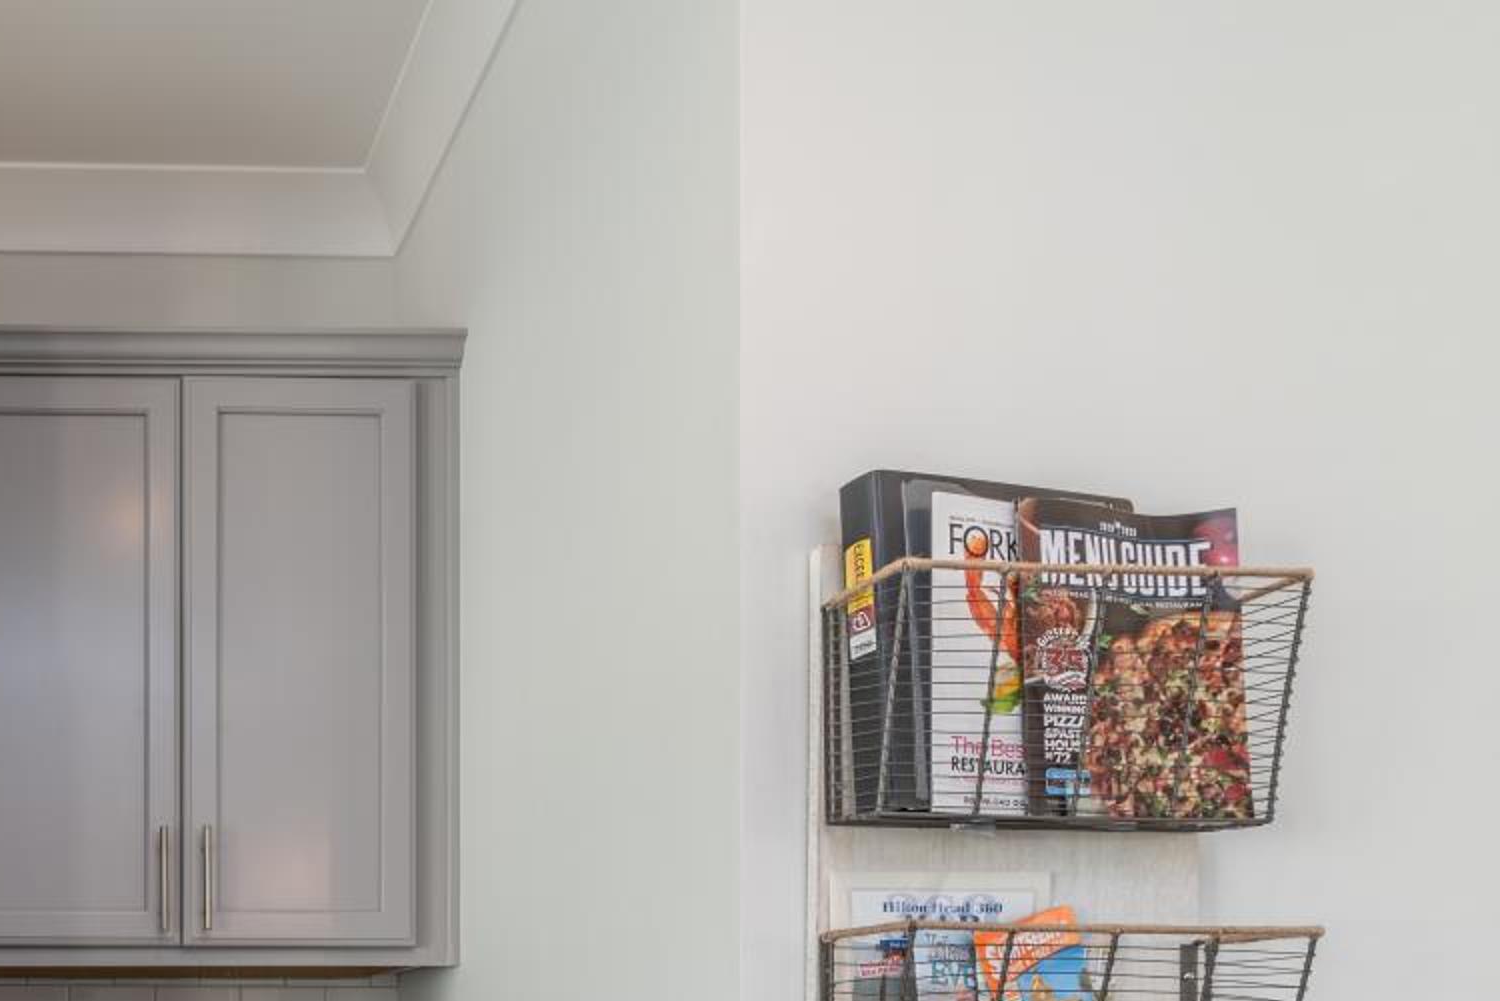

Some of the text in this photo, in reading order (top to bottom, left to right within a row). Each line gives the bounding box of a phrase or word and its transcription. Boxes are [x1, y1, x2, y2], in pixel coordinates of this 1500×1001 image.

[949, 523, 1019, 561] FORK
[1040, 529, 1211, 597] MENU GUIDE
[951, 756, 1026, 775] RESAURA
